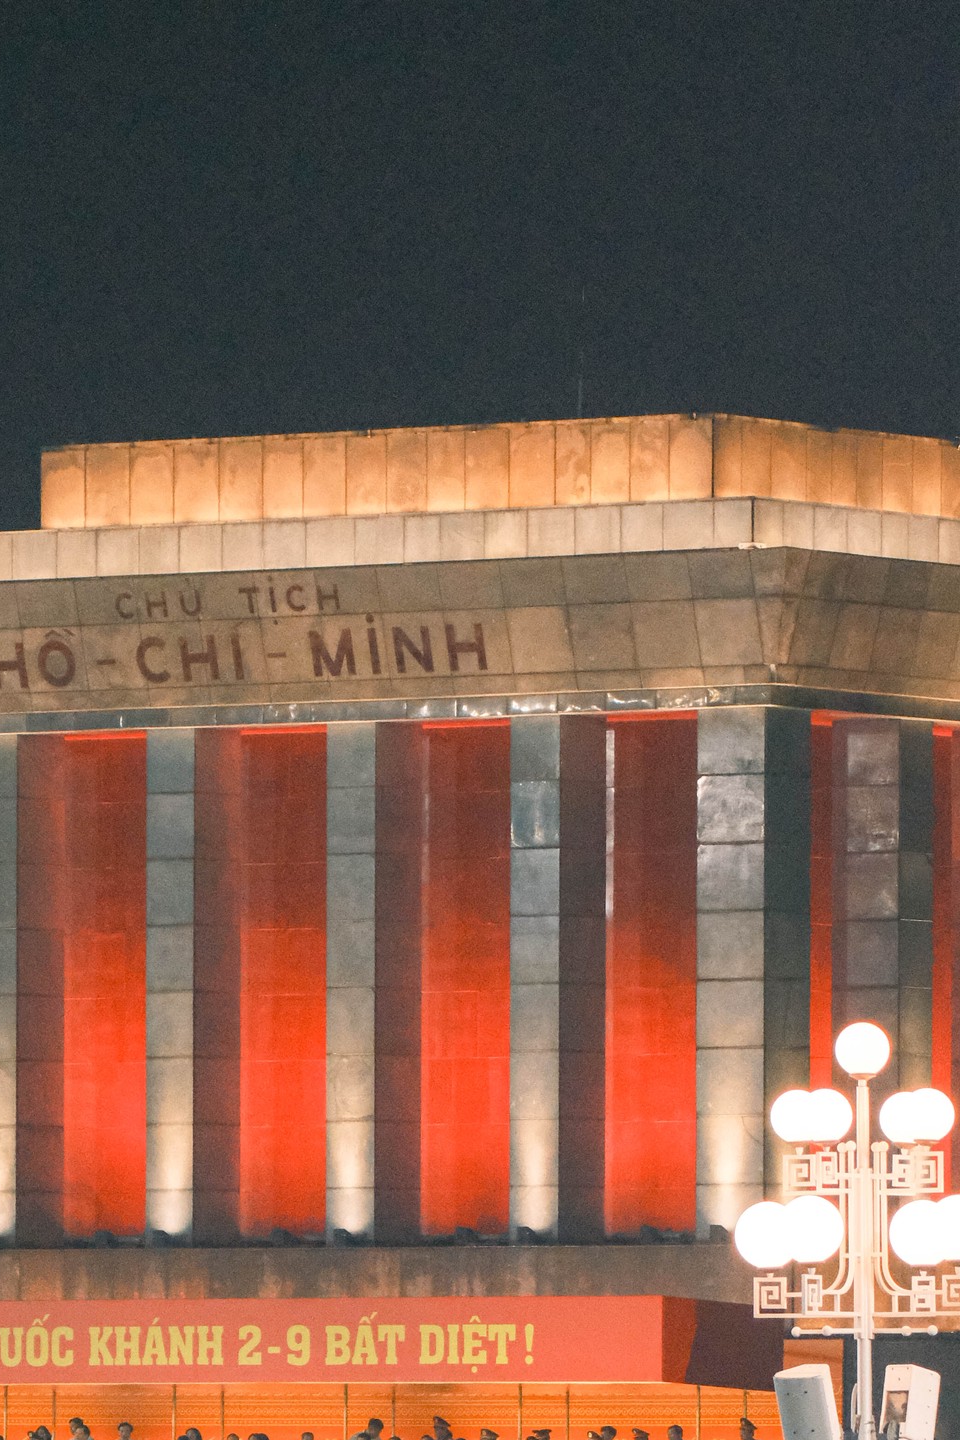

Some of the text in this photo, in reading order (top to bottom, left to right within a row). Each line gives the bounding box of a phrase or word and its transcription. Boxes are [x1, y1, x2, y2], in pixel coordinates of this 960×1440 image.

[88, 1318, 224, 1366] KHÁNH
[238, 1325, 311, 1366] 2-9
[325, 1312, 406, 1366] BẤT
